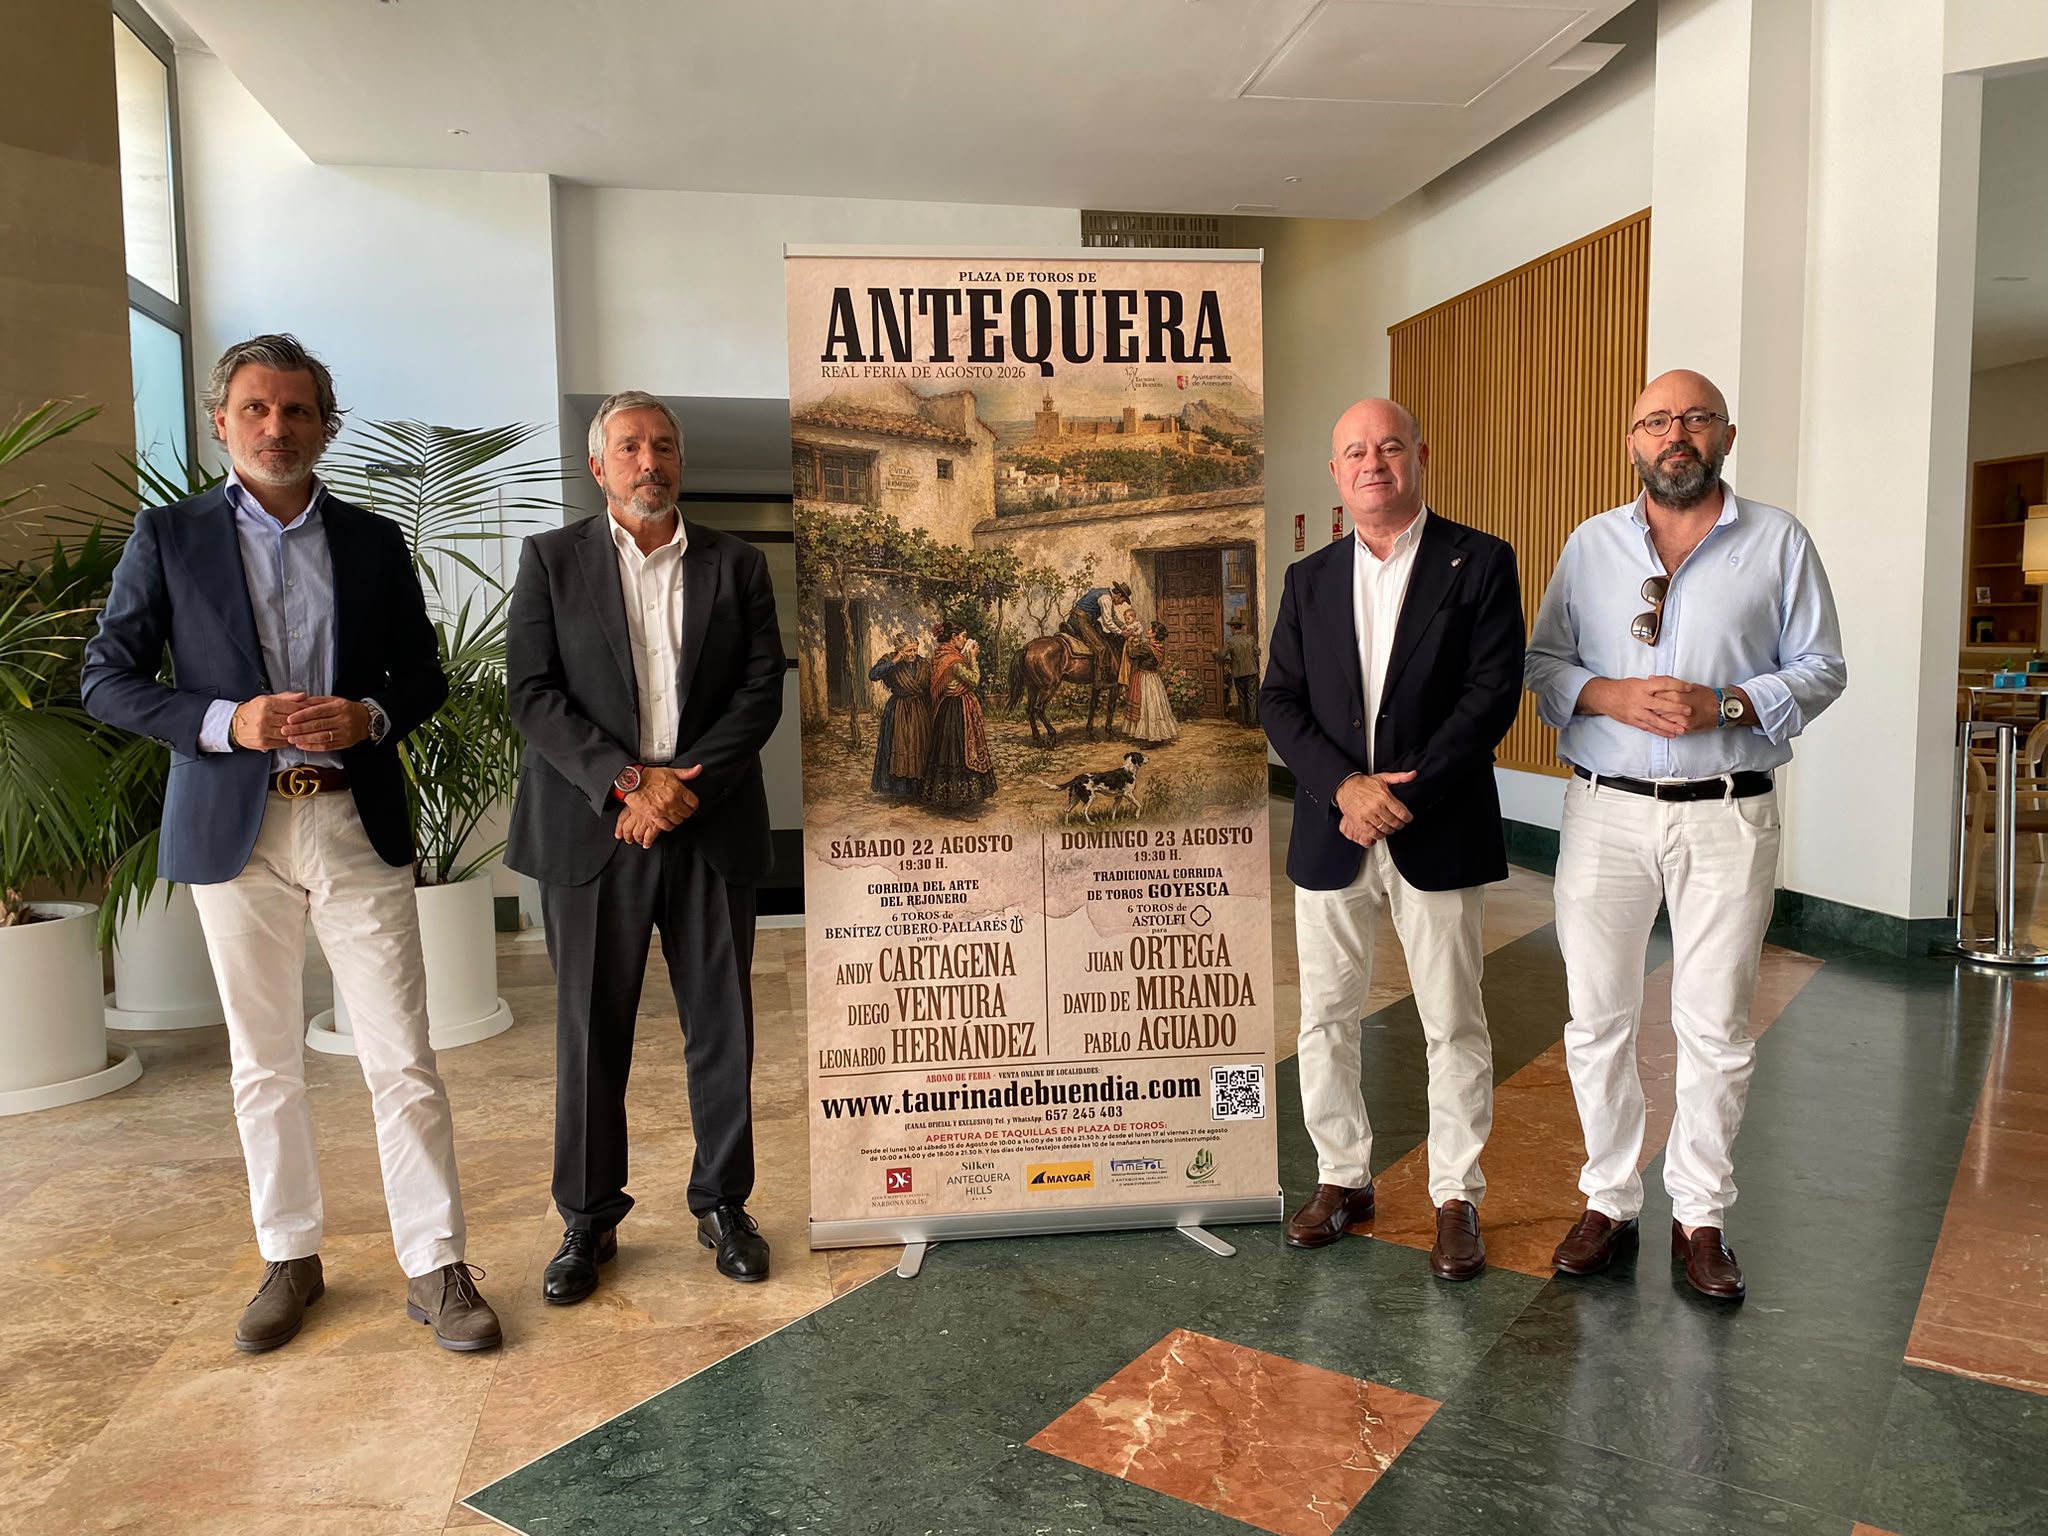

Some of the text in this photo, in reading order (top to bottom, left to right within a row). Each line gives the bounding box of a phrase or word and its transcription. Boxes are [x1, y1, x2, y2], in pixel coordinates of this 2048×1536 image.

[959, 272, 1096, 282] PLAZA DE TOROS DE
[821, 288, 1231, 378] ANTEQUERA
[821, 366, 1025, 379] REAL FERIA DE AGOSTO 2026
[1061, 827, 1253, 850] DOMINGO 23 AGOSTO
[831, 835, 1013, 858] SÁBADO 22 AGOSTO
[1134, 850, 1181, 861] 19:30 H.
[899, 858, 947, 870] 19:30 H.
[1093, 868, 1222, 882] TRADICIONAL CORRIDA
[868, 880, 979, 894] CORRIDA DEL ARTE
[1087, 882, 1229, 901] DE TOROS GOYESCA
[881, 893, 967, 907] DEL REJONERO
[1128, 903, 1187, 913] 6 TOROS de
[901, 911, 940, 921] TOROS
[1132, 914, 1185, 927] ASTOLFI
[825, 918, 1007, 939] BENÍTEZ CUBERO-PALLARÉS
[1084, 934, 1232, 972] JUAN ORTEGA
[836, 942, 1016, 985] ANDY CARTAGENA
[1063, 973, 1256, 1014] DAVID DE MIRANDA
[848, 983, 1007, 1026] DIEGO VENTURA
[1084, 1013, 1236, 1053] PABLO AGUADO
[819, 1020, 1036, 1069] LEONARDO HERNÁNDEZ
[926, 1074, 952, 1083] ABONO
[821, 1075, 1201, 1119] www.taurinadebuendia.com
[905, 1123, 926, 1131] (CANAL
[928, 1120, 951, 1128] OFICIAL
[959, 1118, 993, 1126] EXCLUSIVO)
[1045, 1109, 1068, 1120] 657
[1073, 1108, 1095, 1119] 245
[1100, 1106, 1122, 1117] 403
[926, 1133, 981, 1143] APERTURA
[985, 1131, 998, 1139] DE
[1001, 1127, 1057, 1137] TAQUILLAS
[1078, 1125, 1110, 1133] PLAZA
[1130, 1122, 1167, 1130] TOROS:
[962, 1161, 995, 1170] Silken
[947, 1173, 1010, 1185] ANTEQUERA
[1047, 1174, 1090, 1183] MAYGAR
[966, 1186, 992, 1195] HILLS
